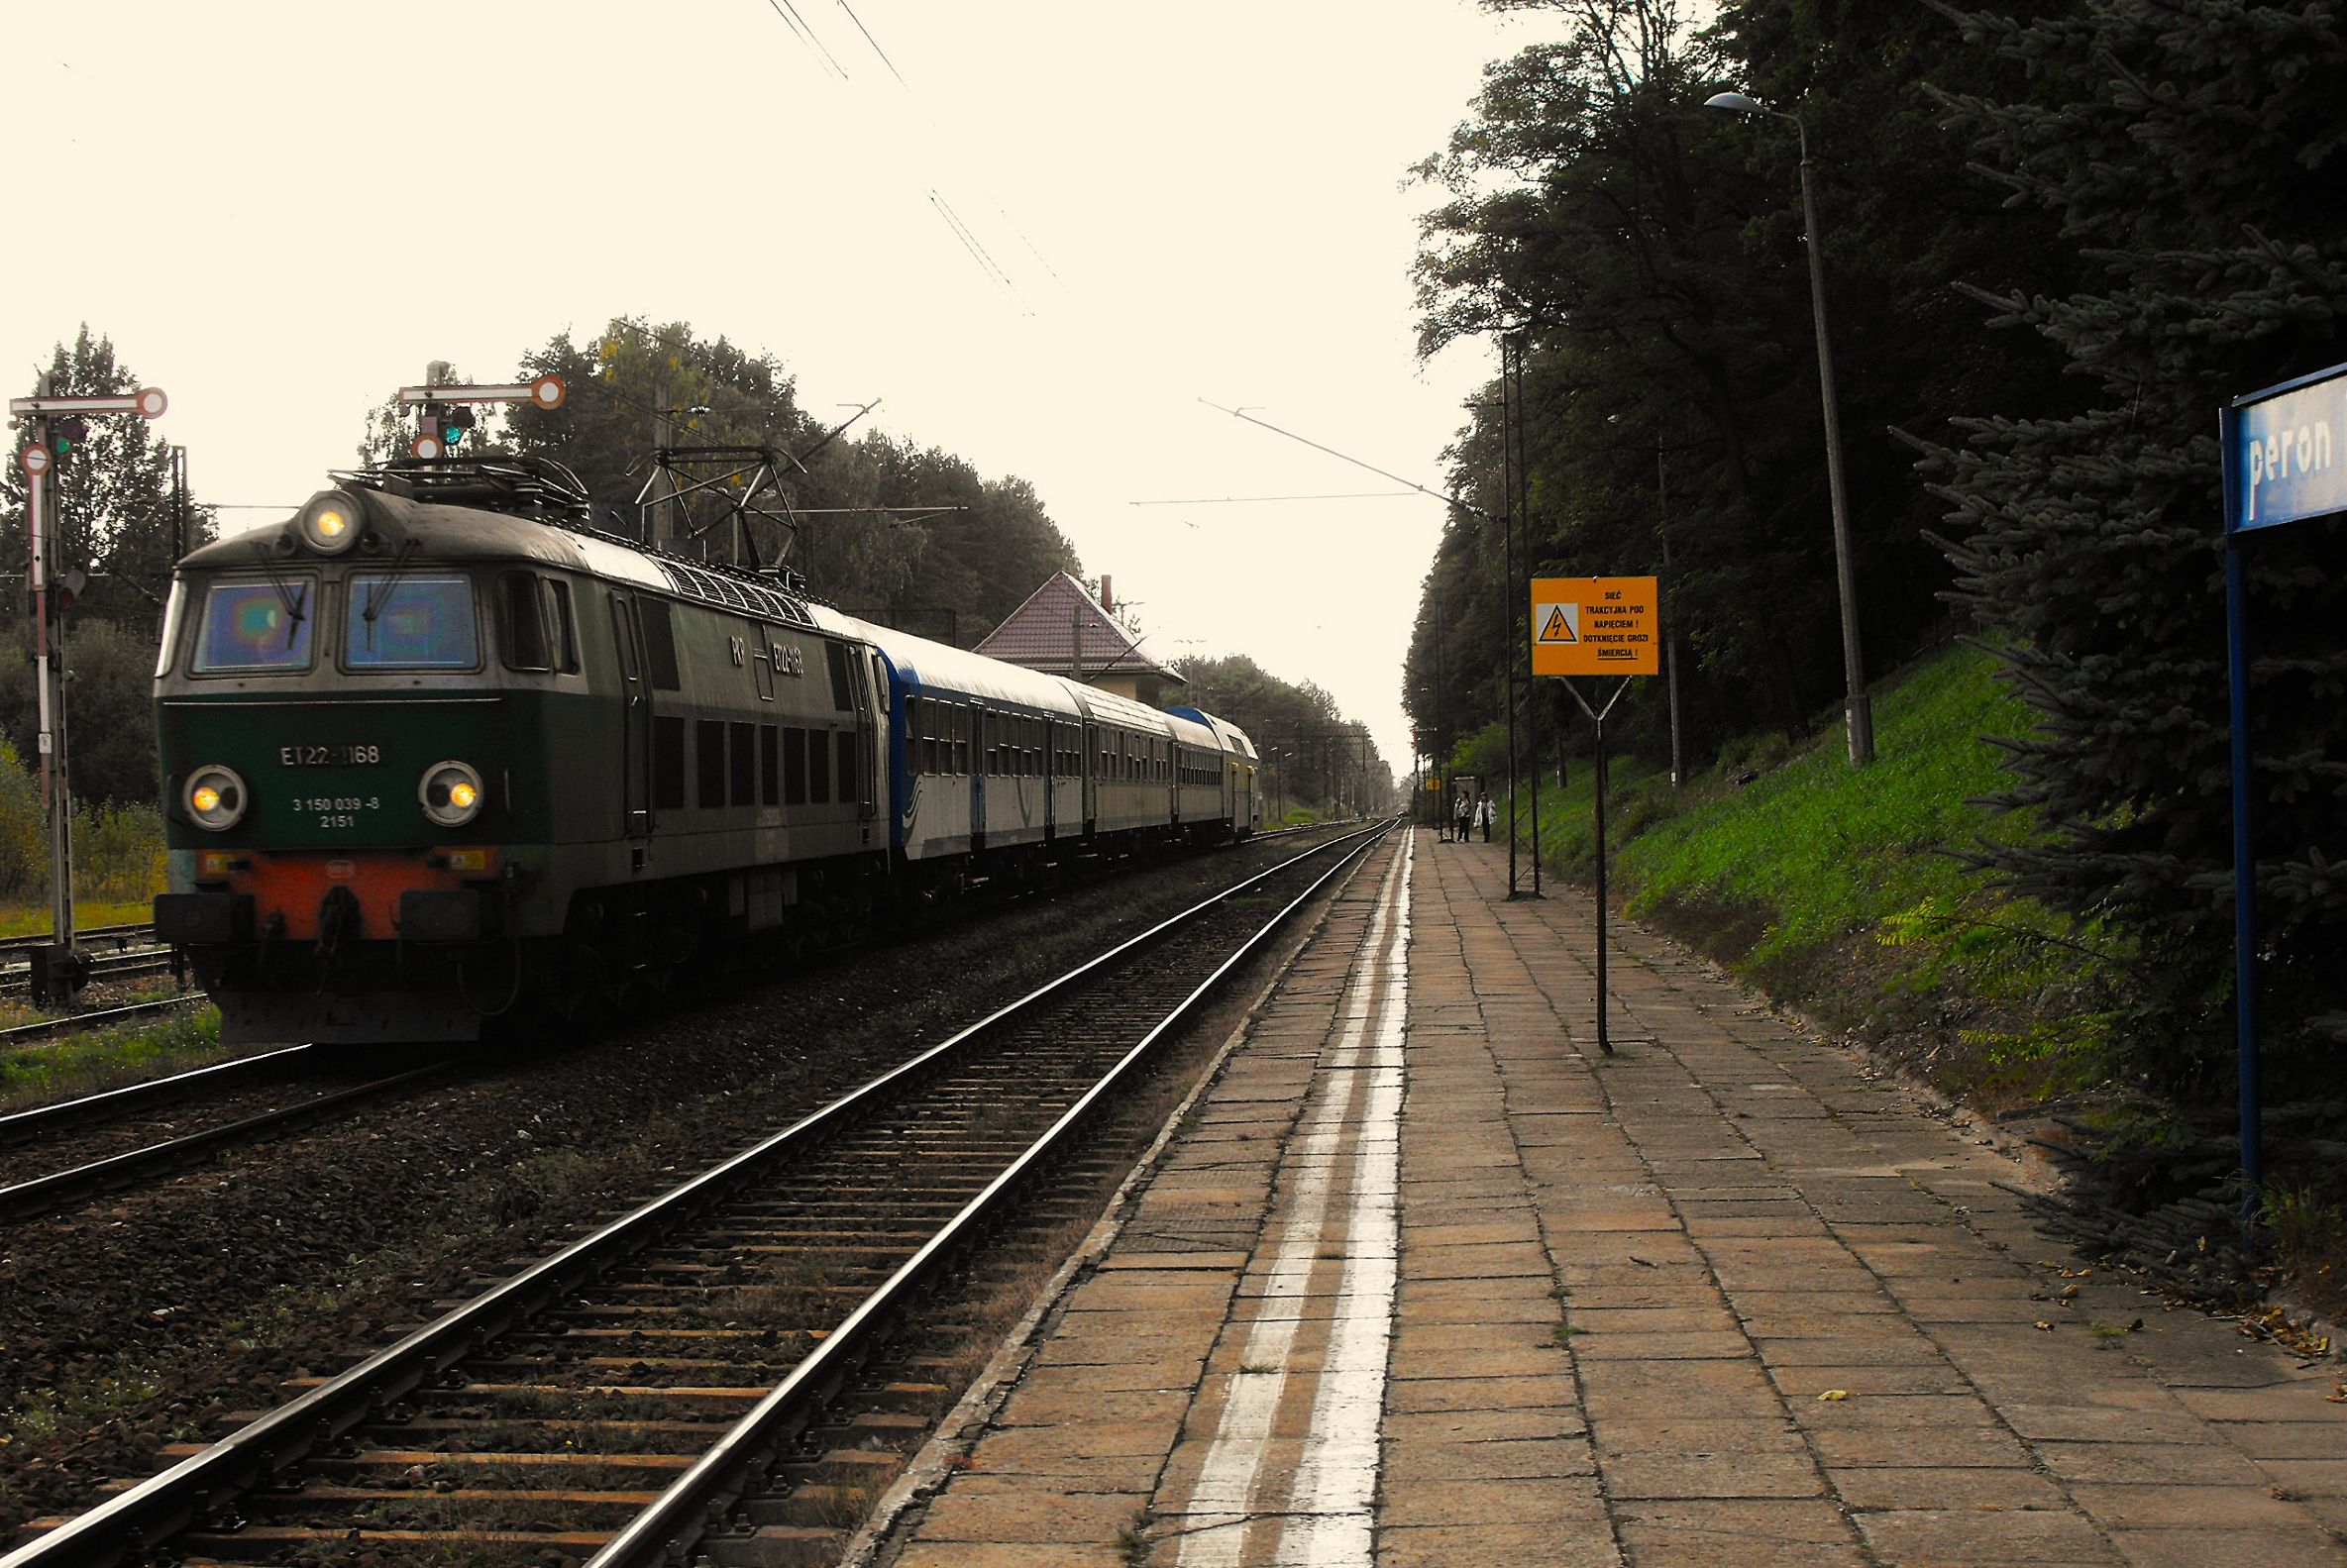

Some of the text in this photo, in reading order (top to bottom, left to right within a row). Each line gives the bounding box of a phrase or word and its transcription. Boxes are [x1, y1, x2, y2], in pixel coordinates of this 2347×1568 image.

[2249, 420, 2331, 521] peron
[1605, 590, 1622, 599] SIEĆ
[1585, 605, 1644, 614] TRAKCYJNA POD
[1627, 634, 1649, 643] GROZI
[292, 798, 302, 811] 3
[305, 798, 332, 811] 150
[335, 797, 362, 810] 039
[319, 815, 355, 828] 2151
